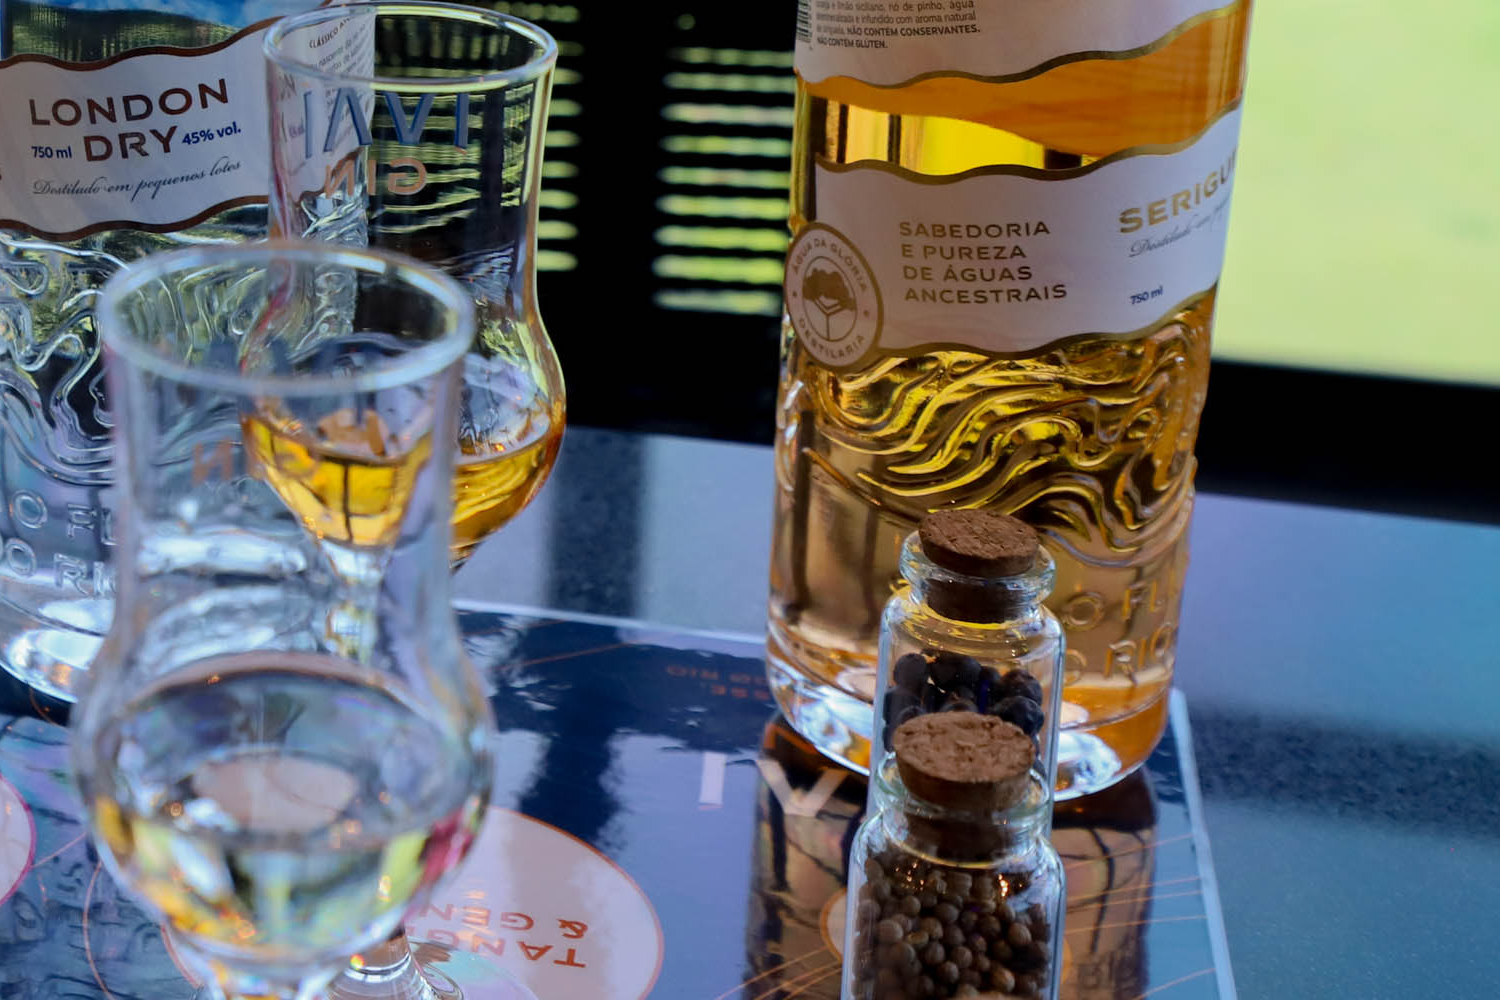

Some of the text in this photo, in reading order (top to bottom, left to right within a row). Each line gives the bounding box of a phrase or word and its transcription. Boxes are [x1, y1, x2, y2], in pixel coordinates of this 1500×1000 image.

[902, 1, 914, 11] de
[950, 0, 974, 12] água
[895, 15, 913, 24] com
[915, 14, 942, 24] aroma
[944, 11, 977, 22] natural
[900, 23, 981, 36] CONSERVANTES.
[28, 77, 230, 126] LONDON
[83, 125, 178, 162] DRY
[181, 121, 242, 146] 45% vol.
[30, 144, 73, 160] 750 ml
[32, 155, 242, 201] Destilado em pequenos lotes
[1119, 148, 1237, 234] SERIGU
[899, 220, 1051, 239] SABEDORIA
[902, 243, 1027, 260] E PUREZA
[903, 261, 1033, 283] DE ÁGUAS
[904, 284, 1069, 304] ANCESTRAIS
[1130, 285, 1164, 305] 750 ml
[557, 918, 589, 939] &
